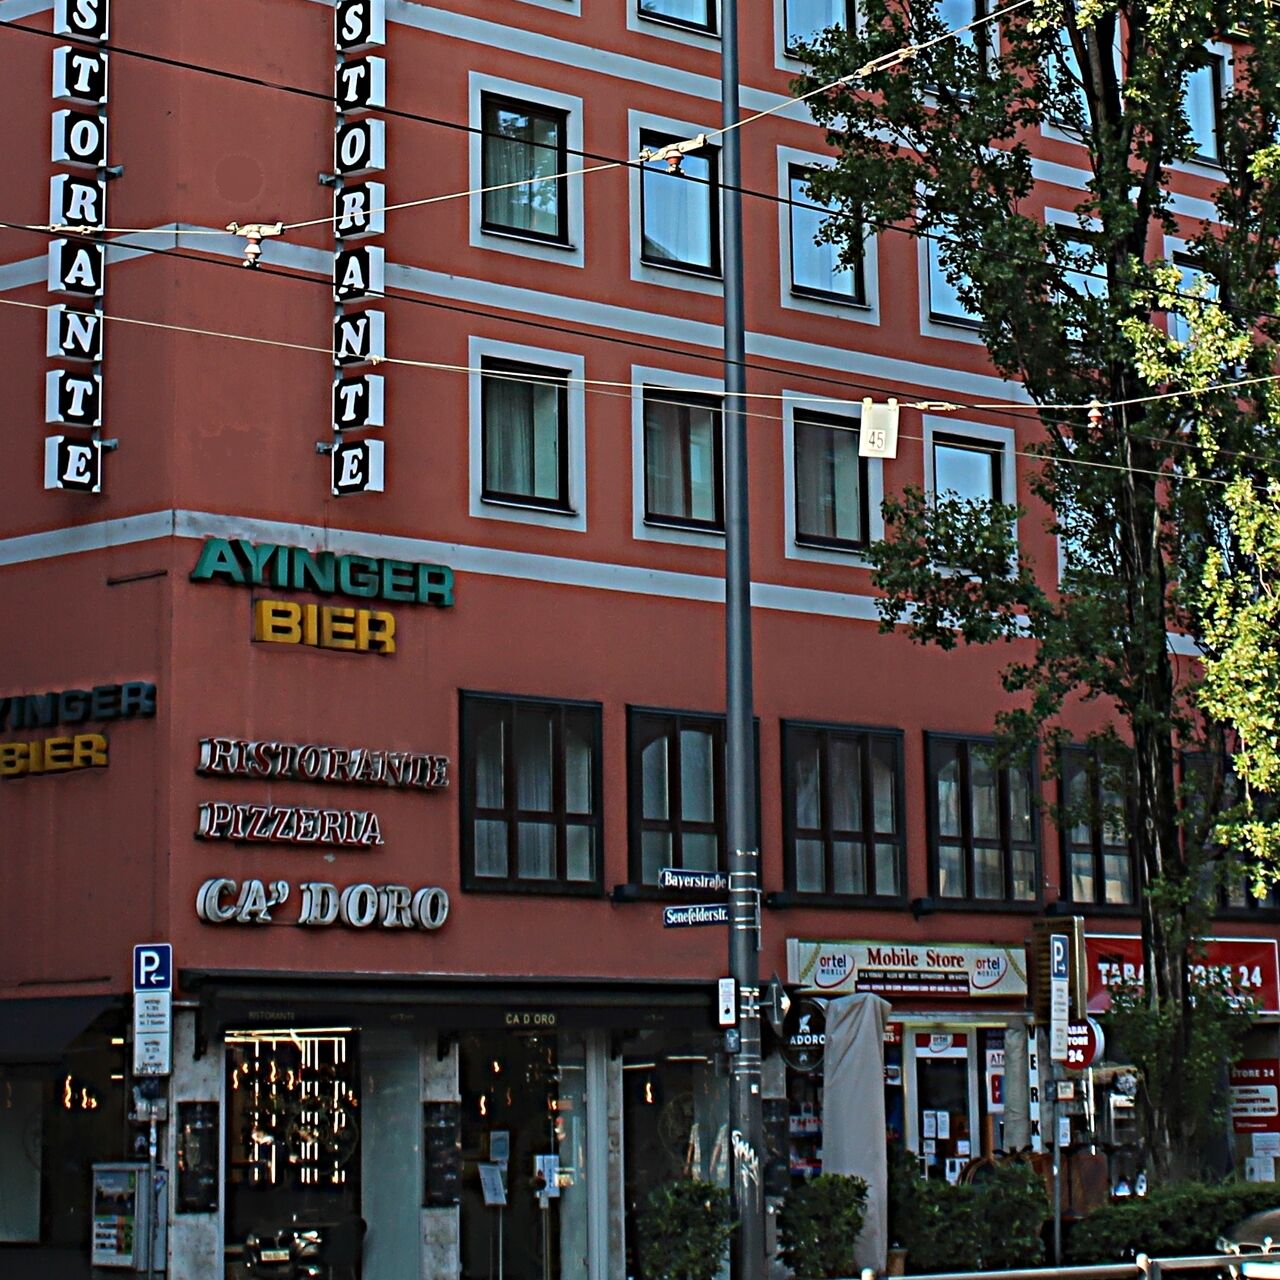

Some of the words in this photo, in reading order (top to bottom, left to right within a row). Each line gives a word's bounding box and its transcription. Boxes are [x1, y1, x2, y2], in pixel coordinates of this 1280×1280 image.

[868, 430, 884, 450] 45
[189, 537, 456, 607] AYINGER
[252, 599, 397, 654] BIER
[197, 737, 451, 789] RISTORANTE
[195, 802, 386, 847] PIZZERIA
[664, 871, 728, 891] Bayerstraße
[196, 877, 290, 924] CA'
[297, 882, 450, 931] DORO
[666, 907, 729, 926] Senefelderstr.
[819, 954, 847, 968] ortel
[867, 946, 919, 966] Mobile
[926, 949, 965, 968] Store
[976, 956, 1001, 970] ortel
[140, 951, 160, 985] P
[821, 968, 848, 976] MOBILE
[1238, 965, 1263, 988] 24
[505, 1012, 519, 1025] CA
[1068, 1049, 1084, 1063] 24
[1263, 1068, 1275, 1077] 24
